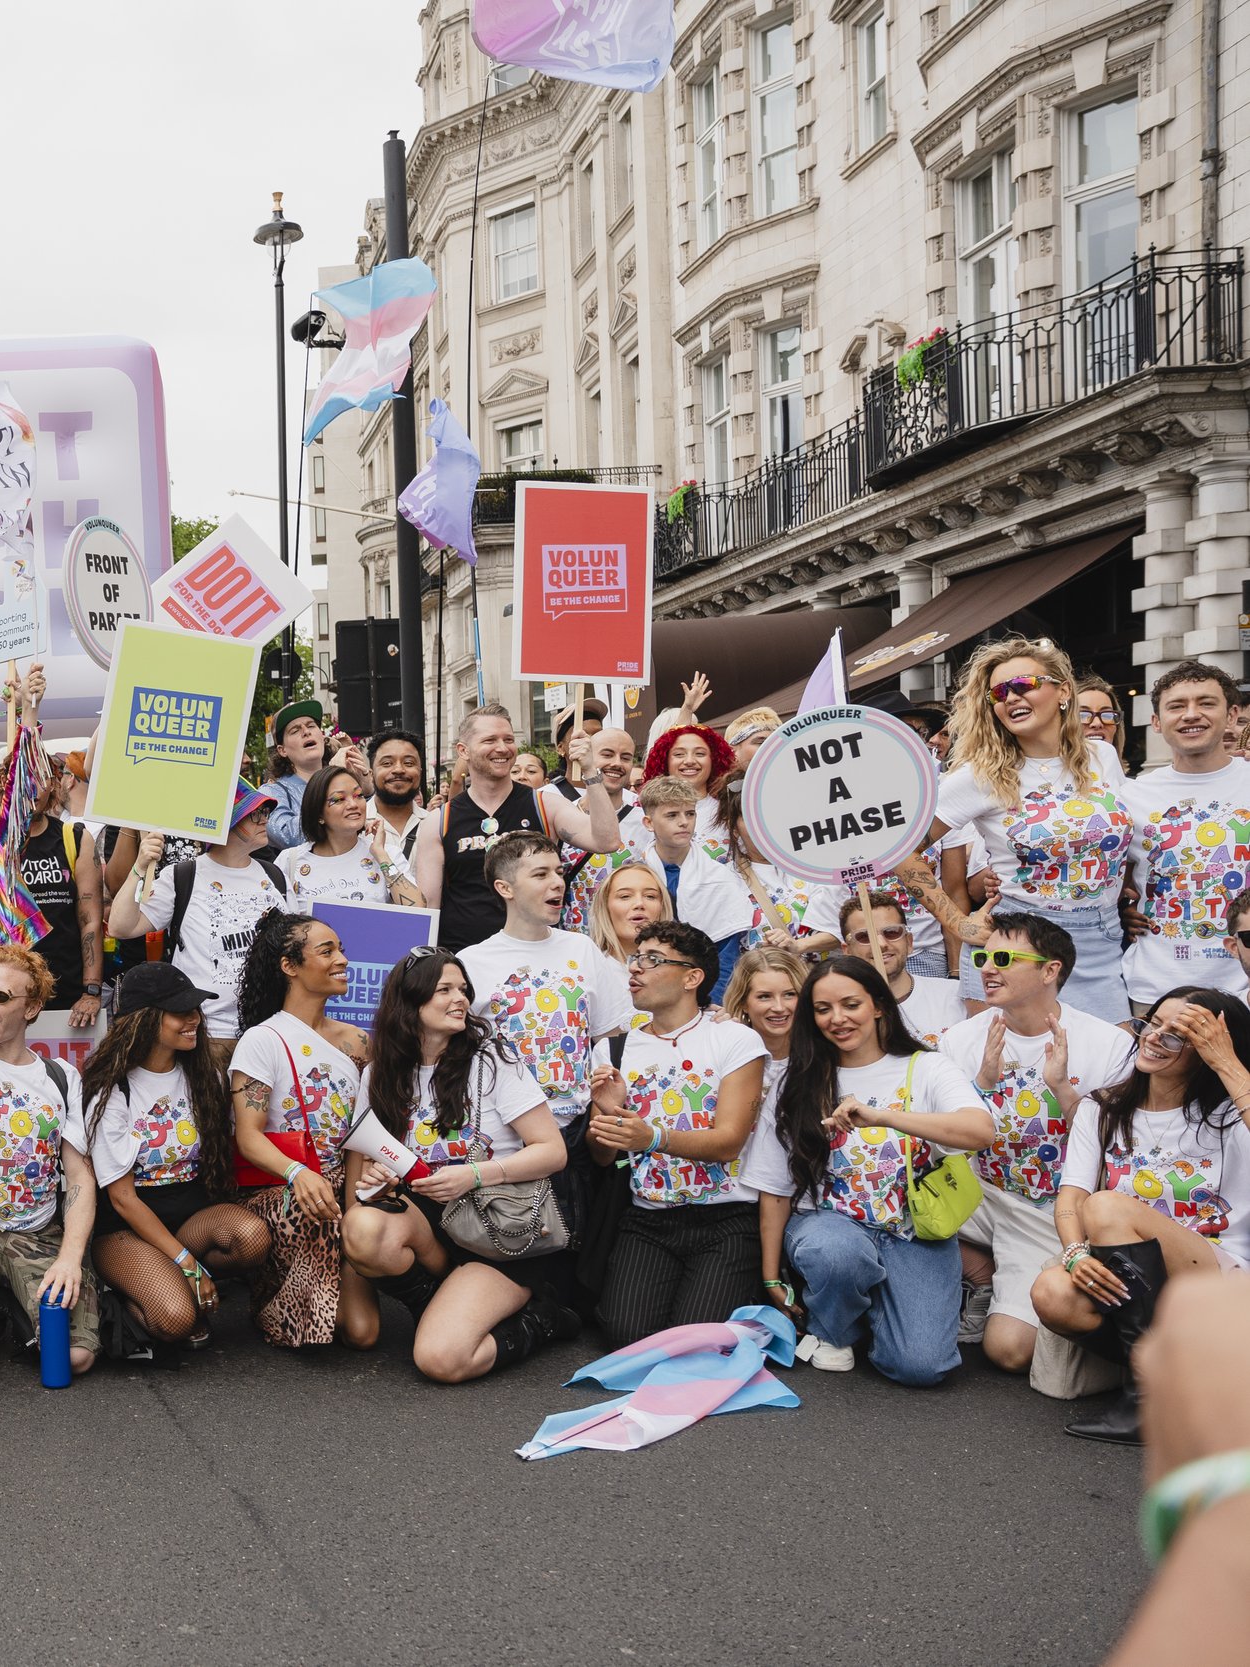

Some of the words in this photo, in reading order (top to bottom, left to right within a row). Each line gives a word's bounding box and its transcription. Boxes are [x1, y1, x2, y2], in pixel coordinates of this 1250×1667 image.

[84, 519, 120, 535] VOLUNQUEER
[84, 552, 129, 575] FRONT
[548, 550, 619, 568] VOLUN
[548, 569, 620, 589] QUEER
[103, 583, 120, 603] OF
[174, 581, 194, 603] FOR
[190, 600, 211, 622] THE
[184, 545, 252, 611] DO
[220, 586, 281, 638] IT
[550, 598, 562, 607] BE
[564, 596, 582, 606] THE
[583, 594, 621, 605] CHANGE
[88, 611, 141, 632] PAR
[8, 635, 31, 650] years
[139, 692, 215, 720] VOLUN
[134, 713, 211, 739] QUEER
[782, 709, 863, 738] VOLUNQUEER
[133, 742, 146, 751] BE
[148, 743, 167, 753] THE
[168, 745, 209, 756] CHANGE
[793, 731, 863, 773] NOT
[828, 776, 853, 804] A
[1025, 792, 1119, 825] JOY
[789, 800, 906, 852] PHASE
[1030, 819, 1070, 841] AS
[1086, 811, 1129, 830] AN
[1160, 818, 1250, 851] JOY
[1027, 839, 1089, 862] ACT
[1100, 833, 1135, 852] OF
[1161, 846, 1196, 869] AS
[1209, 844, 1250, 864] AN
[850, 872, 876, 883] LONDON
[1155, 872, 1211, 894] ACT
[505, 984, 585, 1016] JOY
[327, 1011, 338, 1020] BE
[339, 1012, 357, 1021] THE
[508, 1012, 538, 1033] AS
[548, 1011, 581, 1029] AN
[633, 1082, 713, 1120] JOY
[675, 1111, 710, 1132] AN
[1024, 1117, 1068, 1136] AN
[147, 1119, 198, 1148] JO
[17, 1137, 49, 1155] AN
[146, 1146, 178, 1165] AS
[430, 1140, 468, 1160] AN
[833, 1146, 866, 1170] AS
[832, 1170, 885, 1195] ACT
[1152, 1198, 1198, 1218] AN
